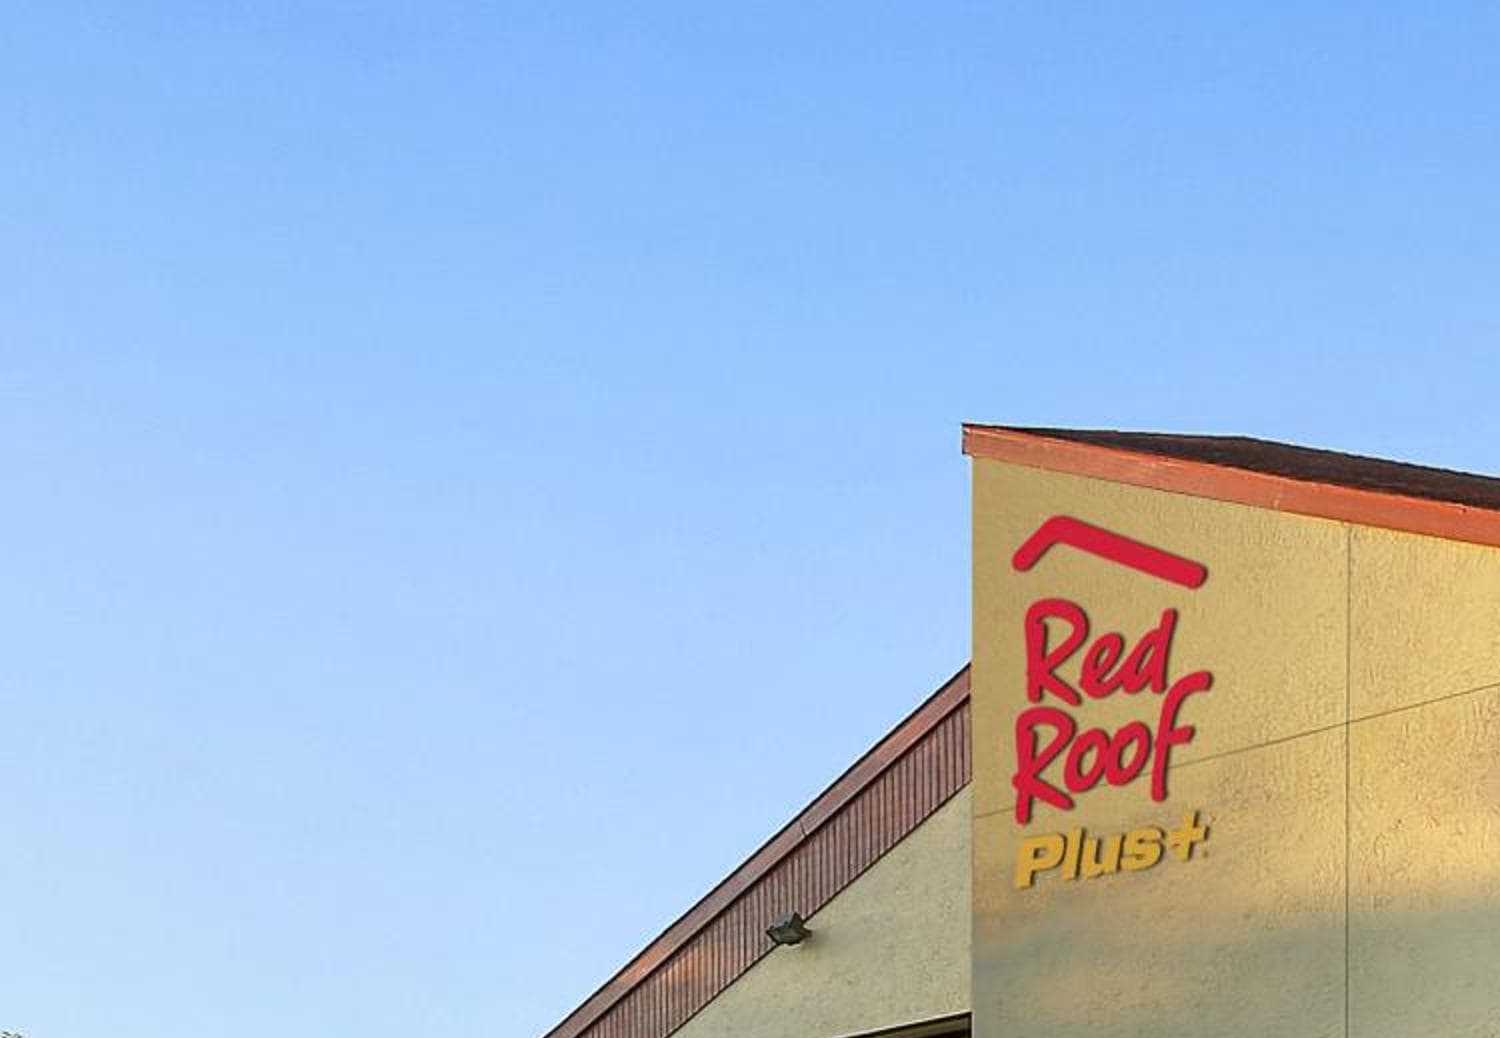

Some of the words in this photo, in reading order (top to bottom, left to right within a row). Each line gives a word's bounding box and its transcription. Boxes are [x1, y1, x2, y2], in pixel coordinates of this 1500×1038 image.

[1024, 598, 1178, 706] Red
[1012, 670, 1213, 825] Roof
[1014, 809, 1212, 890] Plus+
